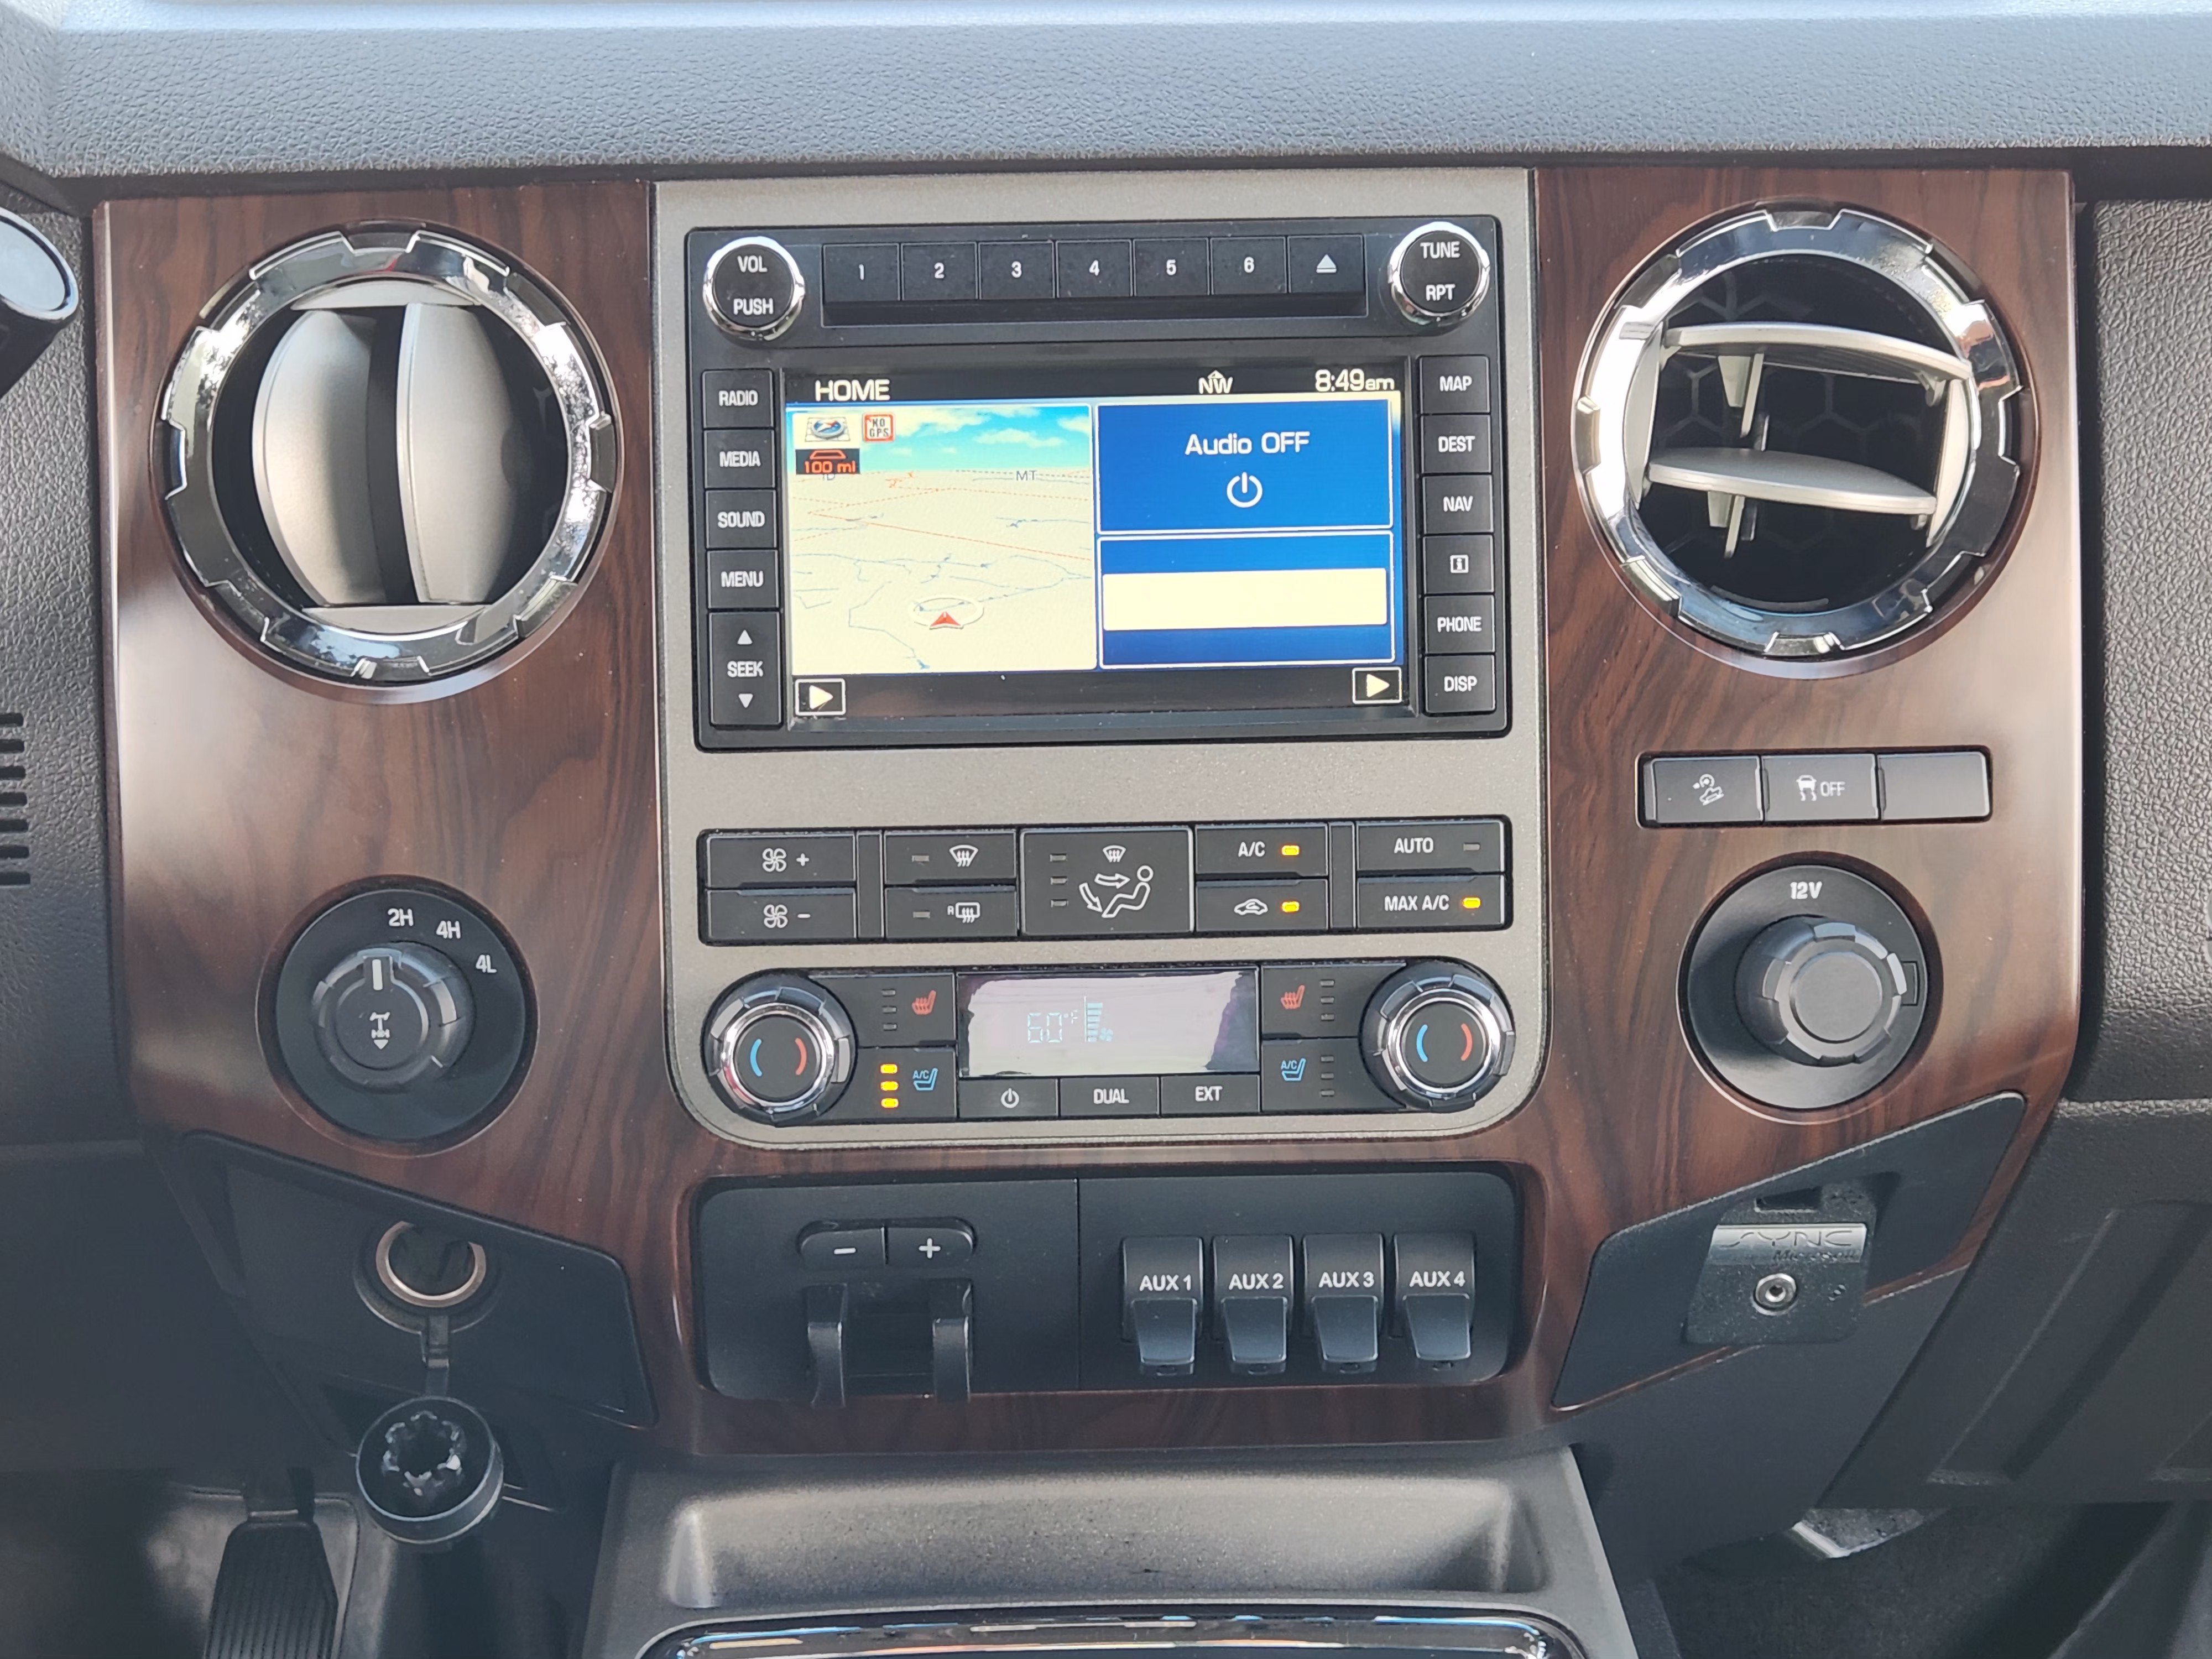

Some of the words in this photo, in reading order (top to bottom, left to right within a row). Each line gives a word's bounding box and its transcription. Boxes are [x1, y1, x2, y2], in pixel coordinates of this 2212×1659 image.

[1420, 241, 1460, 259] TUNE
[737, 255, 768, 273] VOL
[858, 264, 865, 280] 1
[934, 262, 945, 279] 2
[1011, 261, 1022, 278] 3
[1088, 260, 1100, 276] 4
[1166, 259, 1177, 275] 5
[1244, 257, 1255, 273] 6
[1426, 284, 1455, 301] RPT
[733, 298, 774, 315] PUSH
[1198, 377, 1233, 394] NW
[1315, 368, 1395, 392] 8:49am
[1439, 375, 1472, 392] MAP
[718, 390, 758, 406] RADIO
[815, 379, 890, 401] HOME
[869, 427, 889, 437] GPS
[1185, 432, 1253, 455] Audio
[1261, 431, 1310, 453] OFF
[1438, 435, 1476, 452] DEST
[719, 451, 761, 467] MEDIA
[804, 460, 833, 473] 100
[1016, 470, 1038, 481] MT
[1443, 495, 1473, 512] NAV
[717, 511, 765, 528] SOUND
[721, 570, 764, 587] MENU
[1437, 616, 1482, 633] PHONE
[727, 661, 764, 677] SEEK
[1444, 675, 1478, 692] DISP
[1820, 781, 1846, 797] OFF
[1238, 841, 1265, 857] A/C
[1394, 837, 1434, 854] AUTO
[1790, 881, 1823, 900] 12V
[1384, 895, 1418, 911] MAX
[1422, 894, 1449, 911] A/C
[388, 908, 414, 927] 2H
[436, 920, 461, 939] 4H
[476, 954, 497, 973] 4L
[1280, 1060, 1297, 1070] A/C
[912, 1070, 930, 1079] A/C
[1093, 1088, 1130, 1104] DUAL
[1195, 1086, 1223, 1102] EXT
[1720, 1230, 1853, 1248] SYNC
[1139, 1274, 1180, 1291] AUX
[1182, 1274, 1192, 1291] 1
[1228, 1273, 1270, 1290] AUX
[1272, 1272, 1284, 1289] 2
[1318, 1271, 1360, 1288] AUX
[1363, 1271, 1375, 1288] 3
[1409, 1271, 1452, 1287] AUX
[1453, 1271, 1466, 1287] 4
